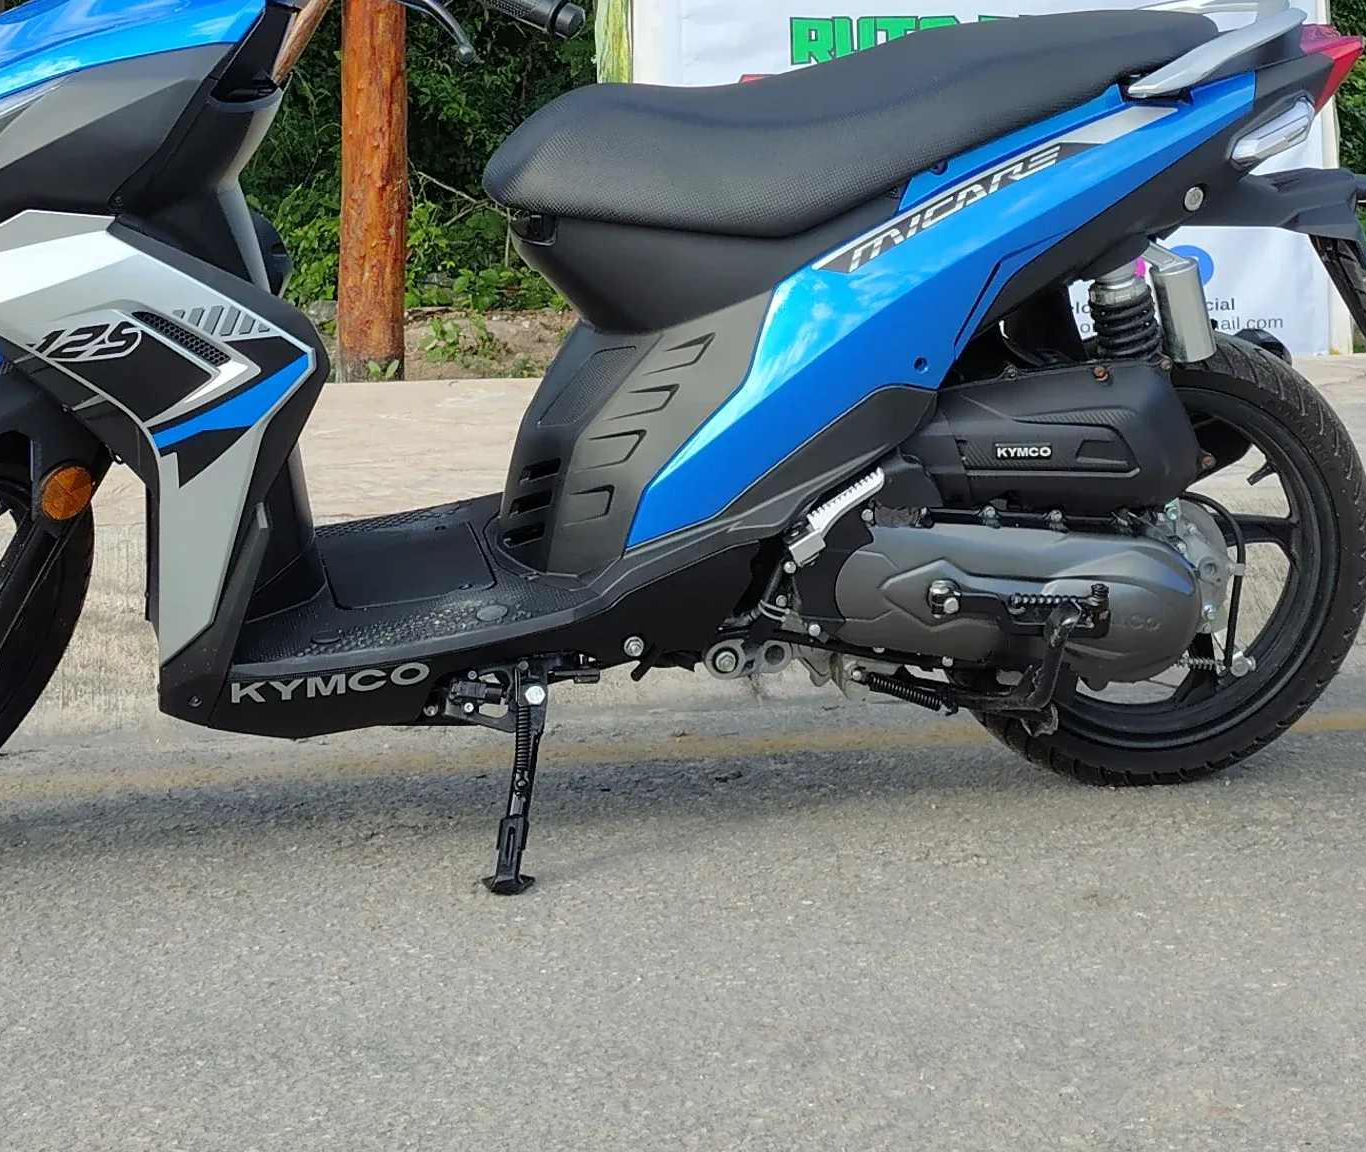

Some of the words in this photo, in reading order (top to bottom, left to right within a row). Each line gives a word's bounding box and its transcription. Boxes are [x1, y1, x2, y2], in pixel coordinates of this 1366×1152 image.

[1206, 297, 1235, 311] cial
[997, 446, 1052, 458] KYMCO
[230, 662, 430, 704] KYMCO
